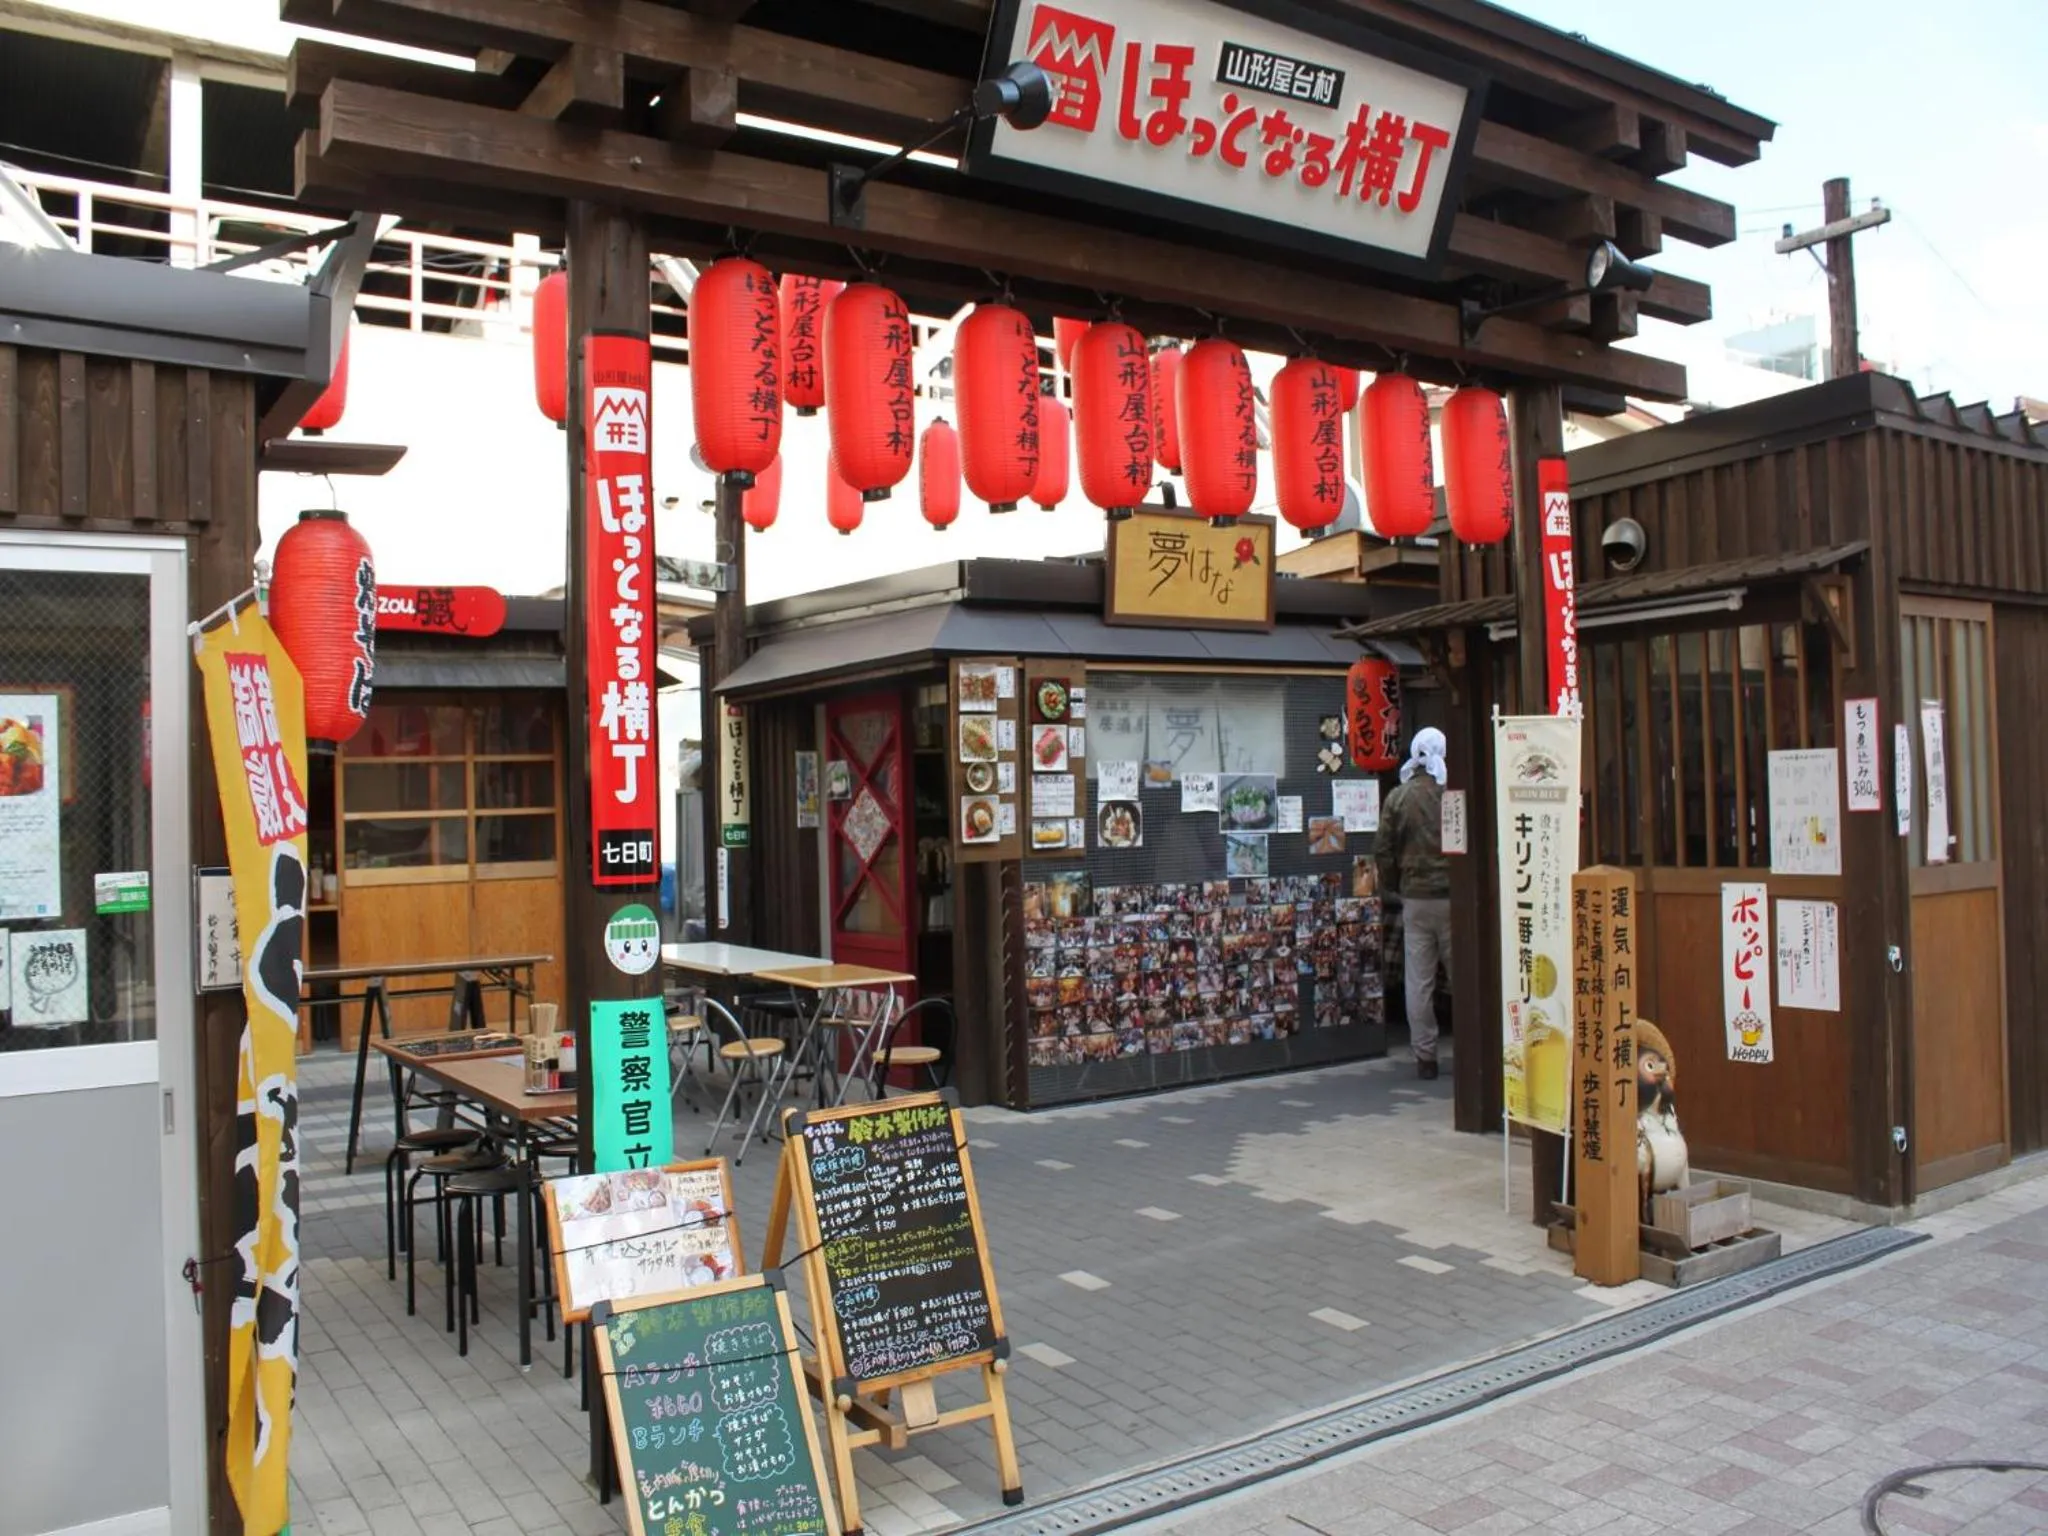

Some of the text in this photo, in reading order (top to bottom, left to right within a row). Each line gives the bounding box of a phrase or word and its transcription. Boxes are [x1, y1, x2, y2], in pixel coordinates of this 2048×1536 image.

[1225, 48, 1337, 105] 山形屋台村
[1115, 40, 1451, 214] ほっとなる横丁
[743, 274, 780, 441] ほっとなる横丁
[882, 292, 913, 459] 山形屋台村
[1015, 320, 1040, 478] ほっとなる横丁
[1116, 332, 1152, 488] 山形屋台村
[1229, 351, 1257, 492] ほっとなる横丁
[1310, 366, 1343, 504] 山形屋台村
[1148, 530, 1236, 605] 夢はな
[596, 474, 650, 804] ほっとなる横丁
[728, 721, 745, 817] ほっとなる横丁
[1855, 703, 1870, 778] もつ煮込み
[602, 841, 652, 864] 七日町
[1513, 813, 1535, 1004] キリン一番搾り
[1731, 888, 1763, 1010] ホッピー
[1574, 888, 1590, 1058] 運気向上致します
[1611, 887, 1633, 1107] 運気向上横丁
[618, 1010, 652, 1170] 警察官立
[1731, 1046, 1770, 1062] Hoppy
[848, 1106, 949, 1145] 鈴木製作所
[1582, 1071, 1604, 1161] 歩行禁煙
[623, 1352, 700, 1389] Aランチ
[631, 1417, 704, 1450] Bランチ
[726, 1408, 773, 1433] 焼きそば
[734, 1428, 766, 1447] サラダ
[734, 1442, 768, 1461] みそ汁
[736, 1453, 786, 1475] お漬けもの
[647, 1486, 726, 1521] とんかつ
